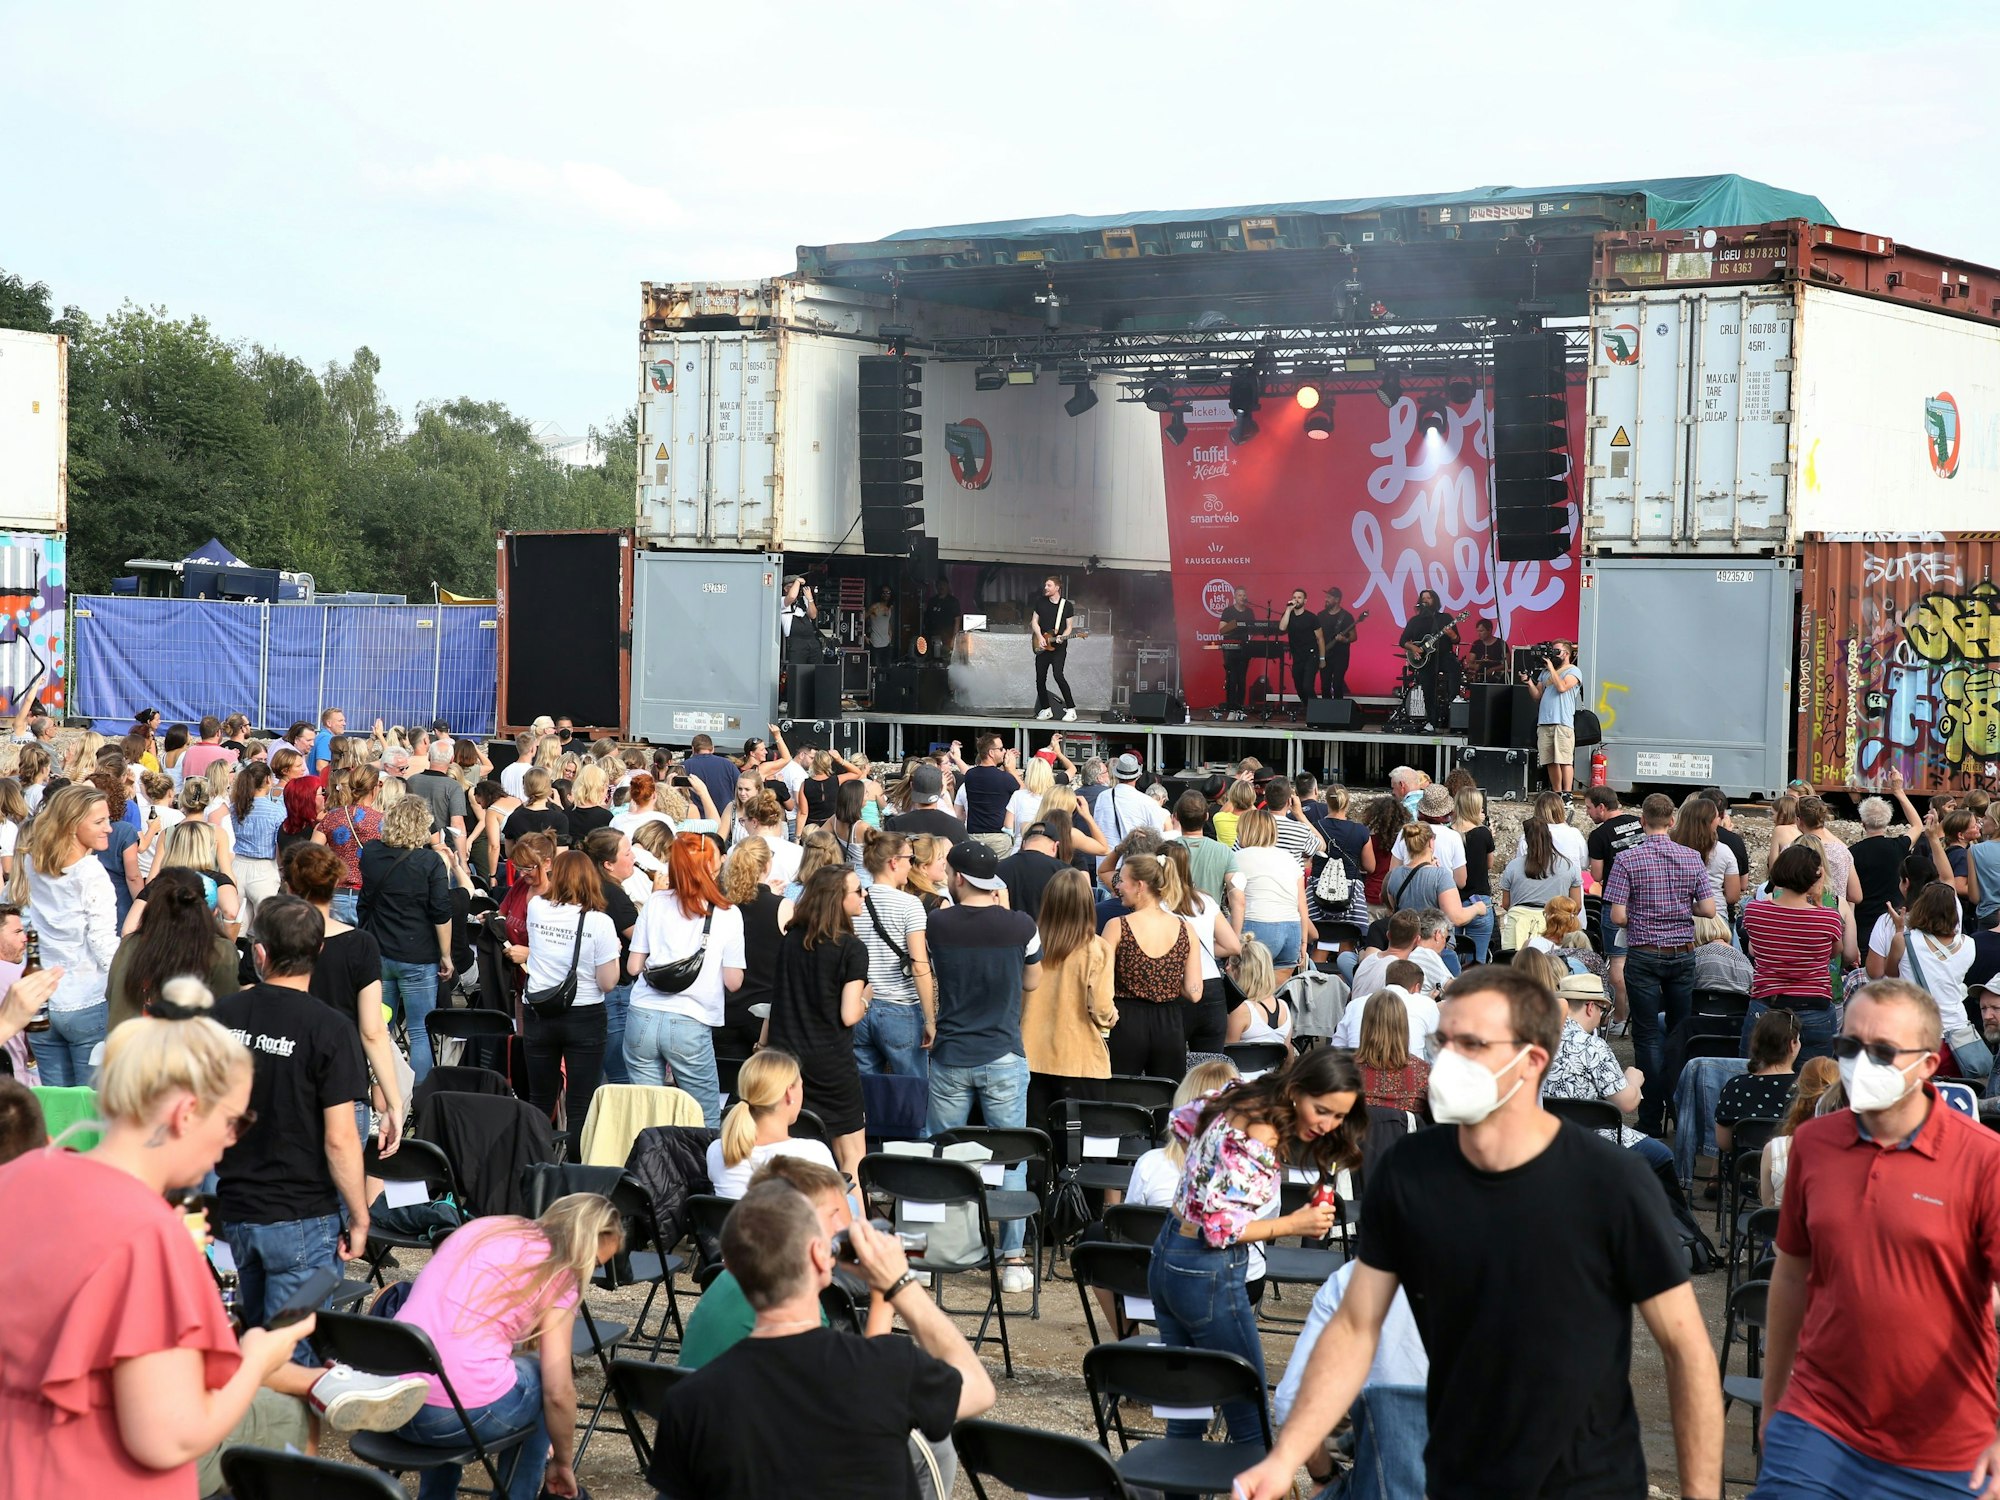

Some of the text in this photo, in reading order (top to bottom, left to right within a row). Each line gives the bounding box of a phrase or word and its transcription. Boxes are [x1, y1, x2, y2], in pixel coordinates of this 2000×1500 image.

[1719, 249, 1741, 261] LGEU
[1719, 263, 1730, 274] US
[1732, 262, 1752, 274] 4363
[1720, 322, 1787, 335] CRLU 160788 0
[1747, 340, 1766, 352] 45R1
[1705, 386, 1722, 397] TARE
[1704, 398, 1718, 409] NET
[1191, 405, 1227, 417] icket.io
[1193, 445, 1229, 463] Gaffel
[1193, 462, 1230, 480] Kölsch
[1190, 511, 1239, 524] smartvélo
[1185, 557, 1251, 565] RAUSGEGANGEN
[1717, 570, 1745, 582] 492352
[1213, 593, 1226, 602] ist
[1597, 682, 1629, 731] 5
[540, 925, 573, 935] KLEINSTE
[574, 930, 592, 939] CUB
[555, 933, 575, 941] WELT
[253, 1033, 296, 1054] Rockt
